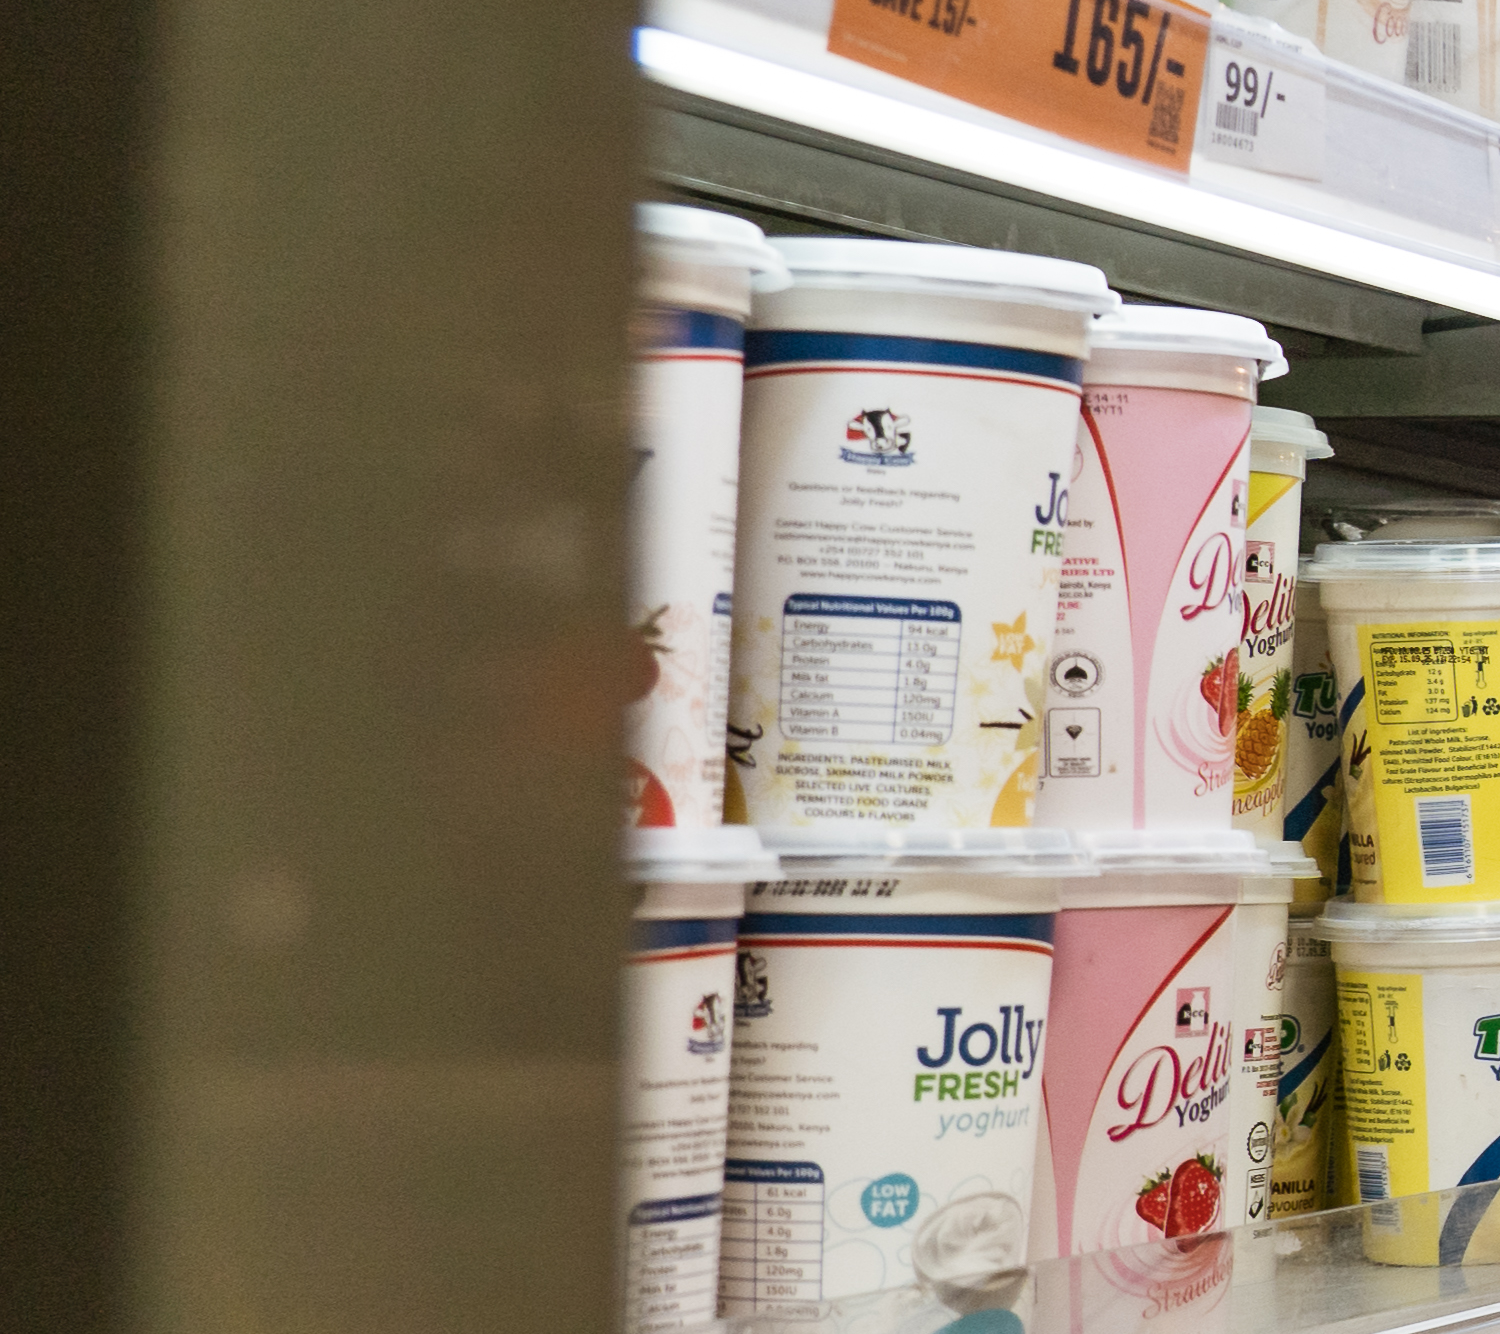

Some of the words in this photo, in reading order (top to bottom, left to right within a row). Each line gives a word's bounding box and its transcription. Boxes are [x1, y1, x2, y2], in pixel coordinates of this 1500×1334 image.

[1224, 60, 1287, 119] 99/-
[916, 1004, 1045, 1081] Jolly
[913, 1069, 1020, 1103] FRESH
[934, 1104, 1032, 1141] yoghurt
[871, 1183, 911, 1202] LOW
[1271, 1178, 1316, 1196] ANILLA
[871, 1199, 911, 1219] FAT
